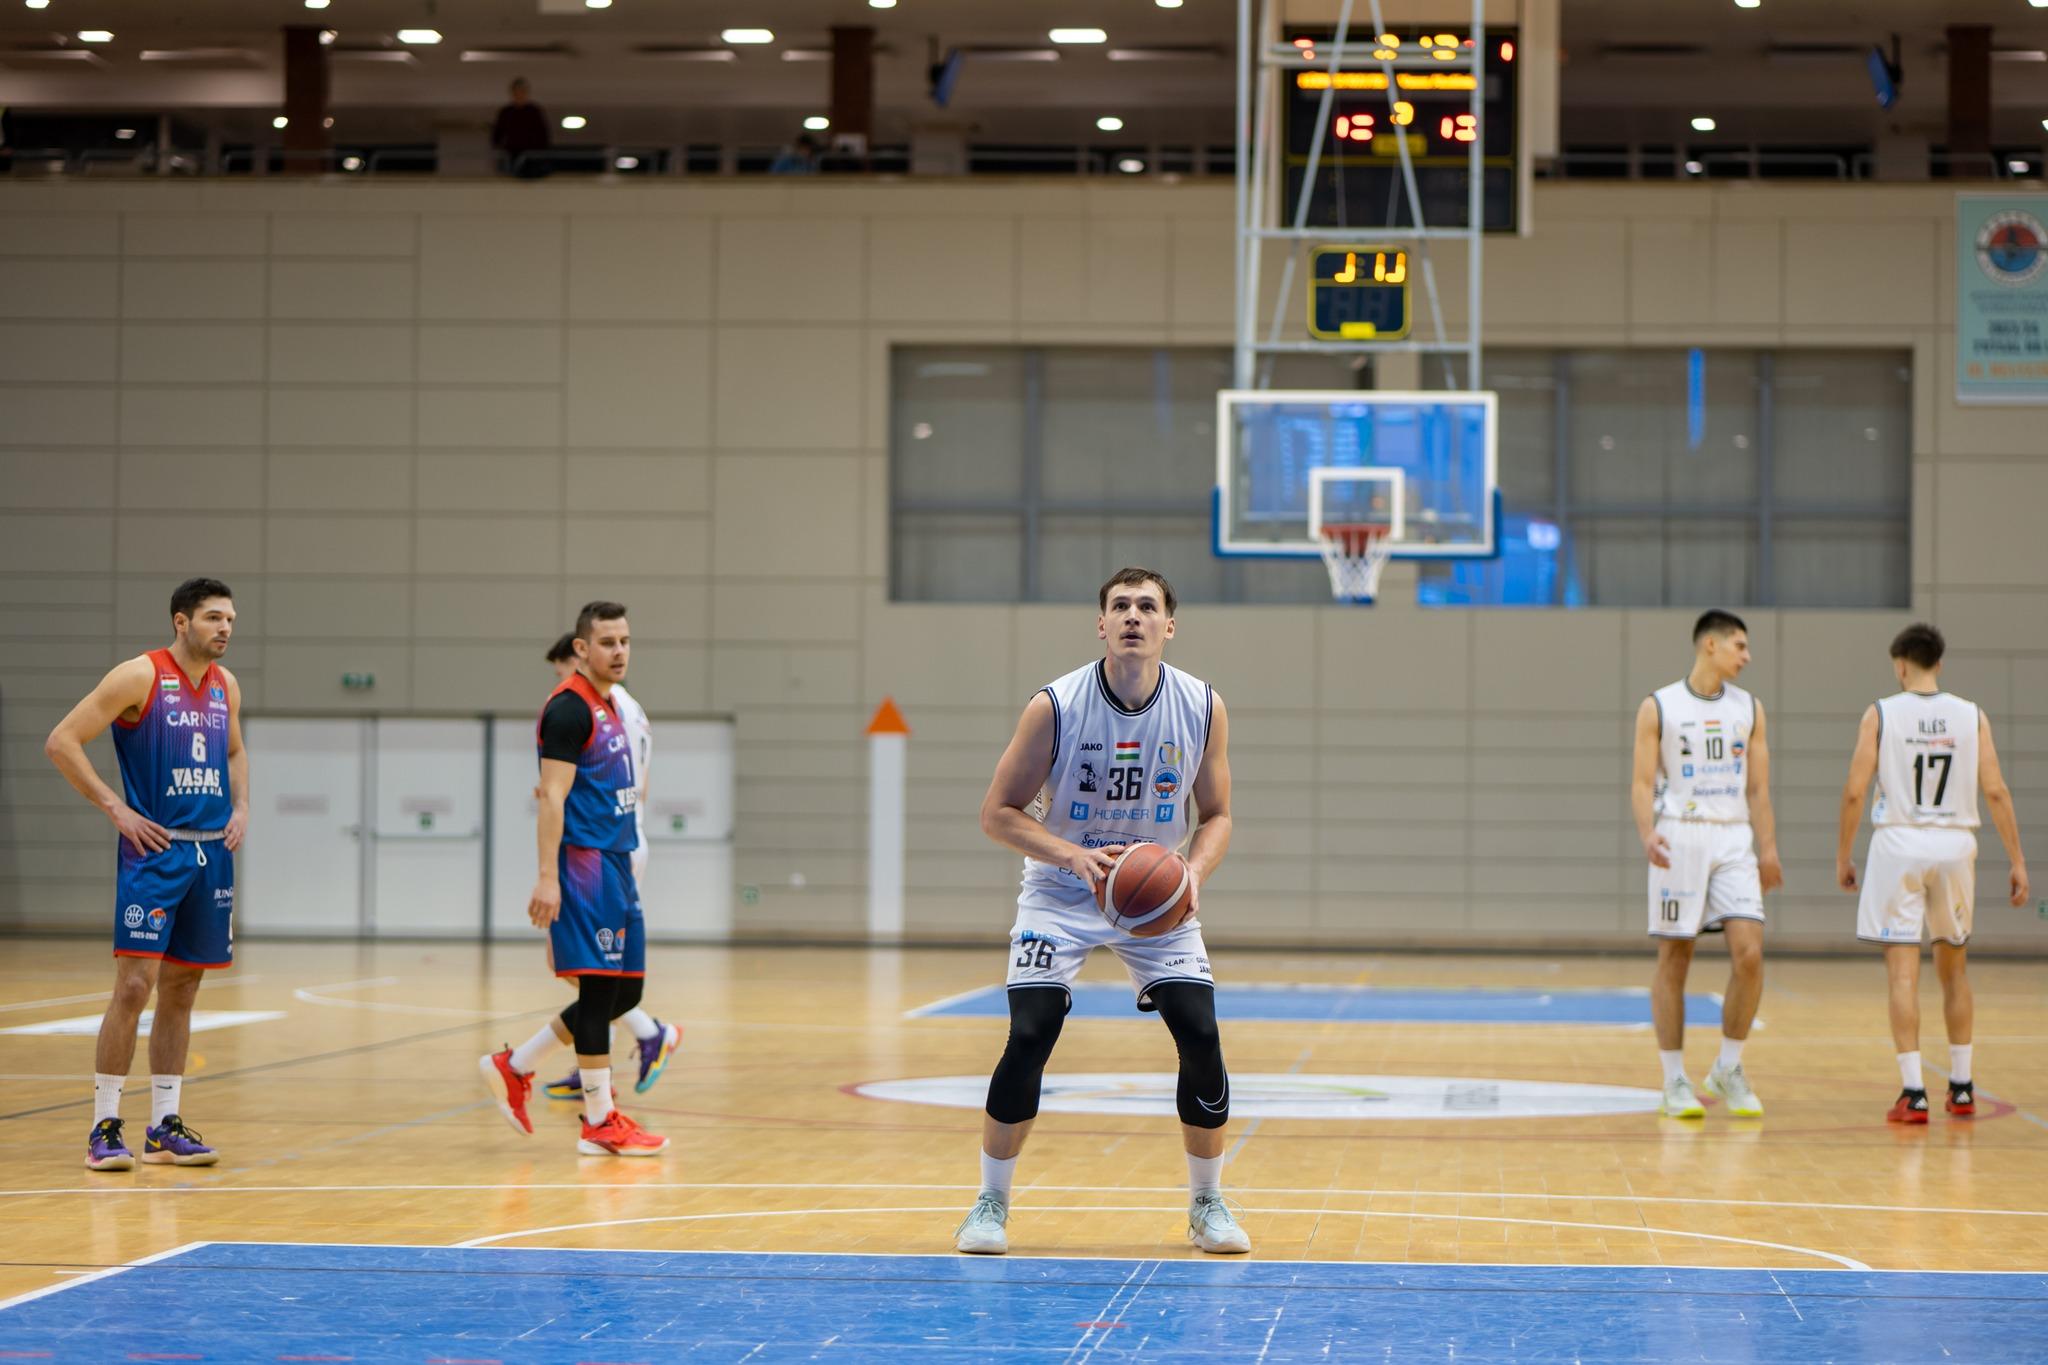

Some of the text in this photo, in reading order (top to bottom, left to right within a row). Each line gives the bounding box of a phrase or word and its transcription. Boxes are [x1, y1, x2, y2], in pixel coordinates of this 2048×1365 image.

[167, 711, 226, 729] CARNET
[192, 732, 206, 763] 6
[1080, 743, 1103, 751] JAKO
[1706, 736, 1723, 760] 10
[172, 767, 220, 787] VASAS
[1106, 767, 1143, 800] 36
[1913, 753, 1952, 805] 17
[1661, 899, 1679, 921] 10
[1016, 938, 1057, 970] 36
